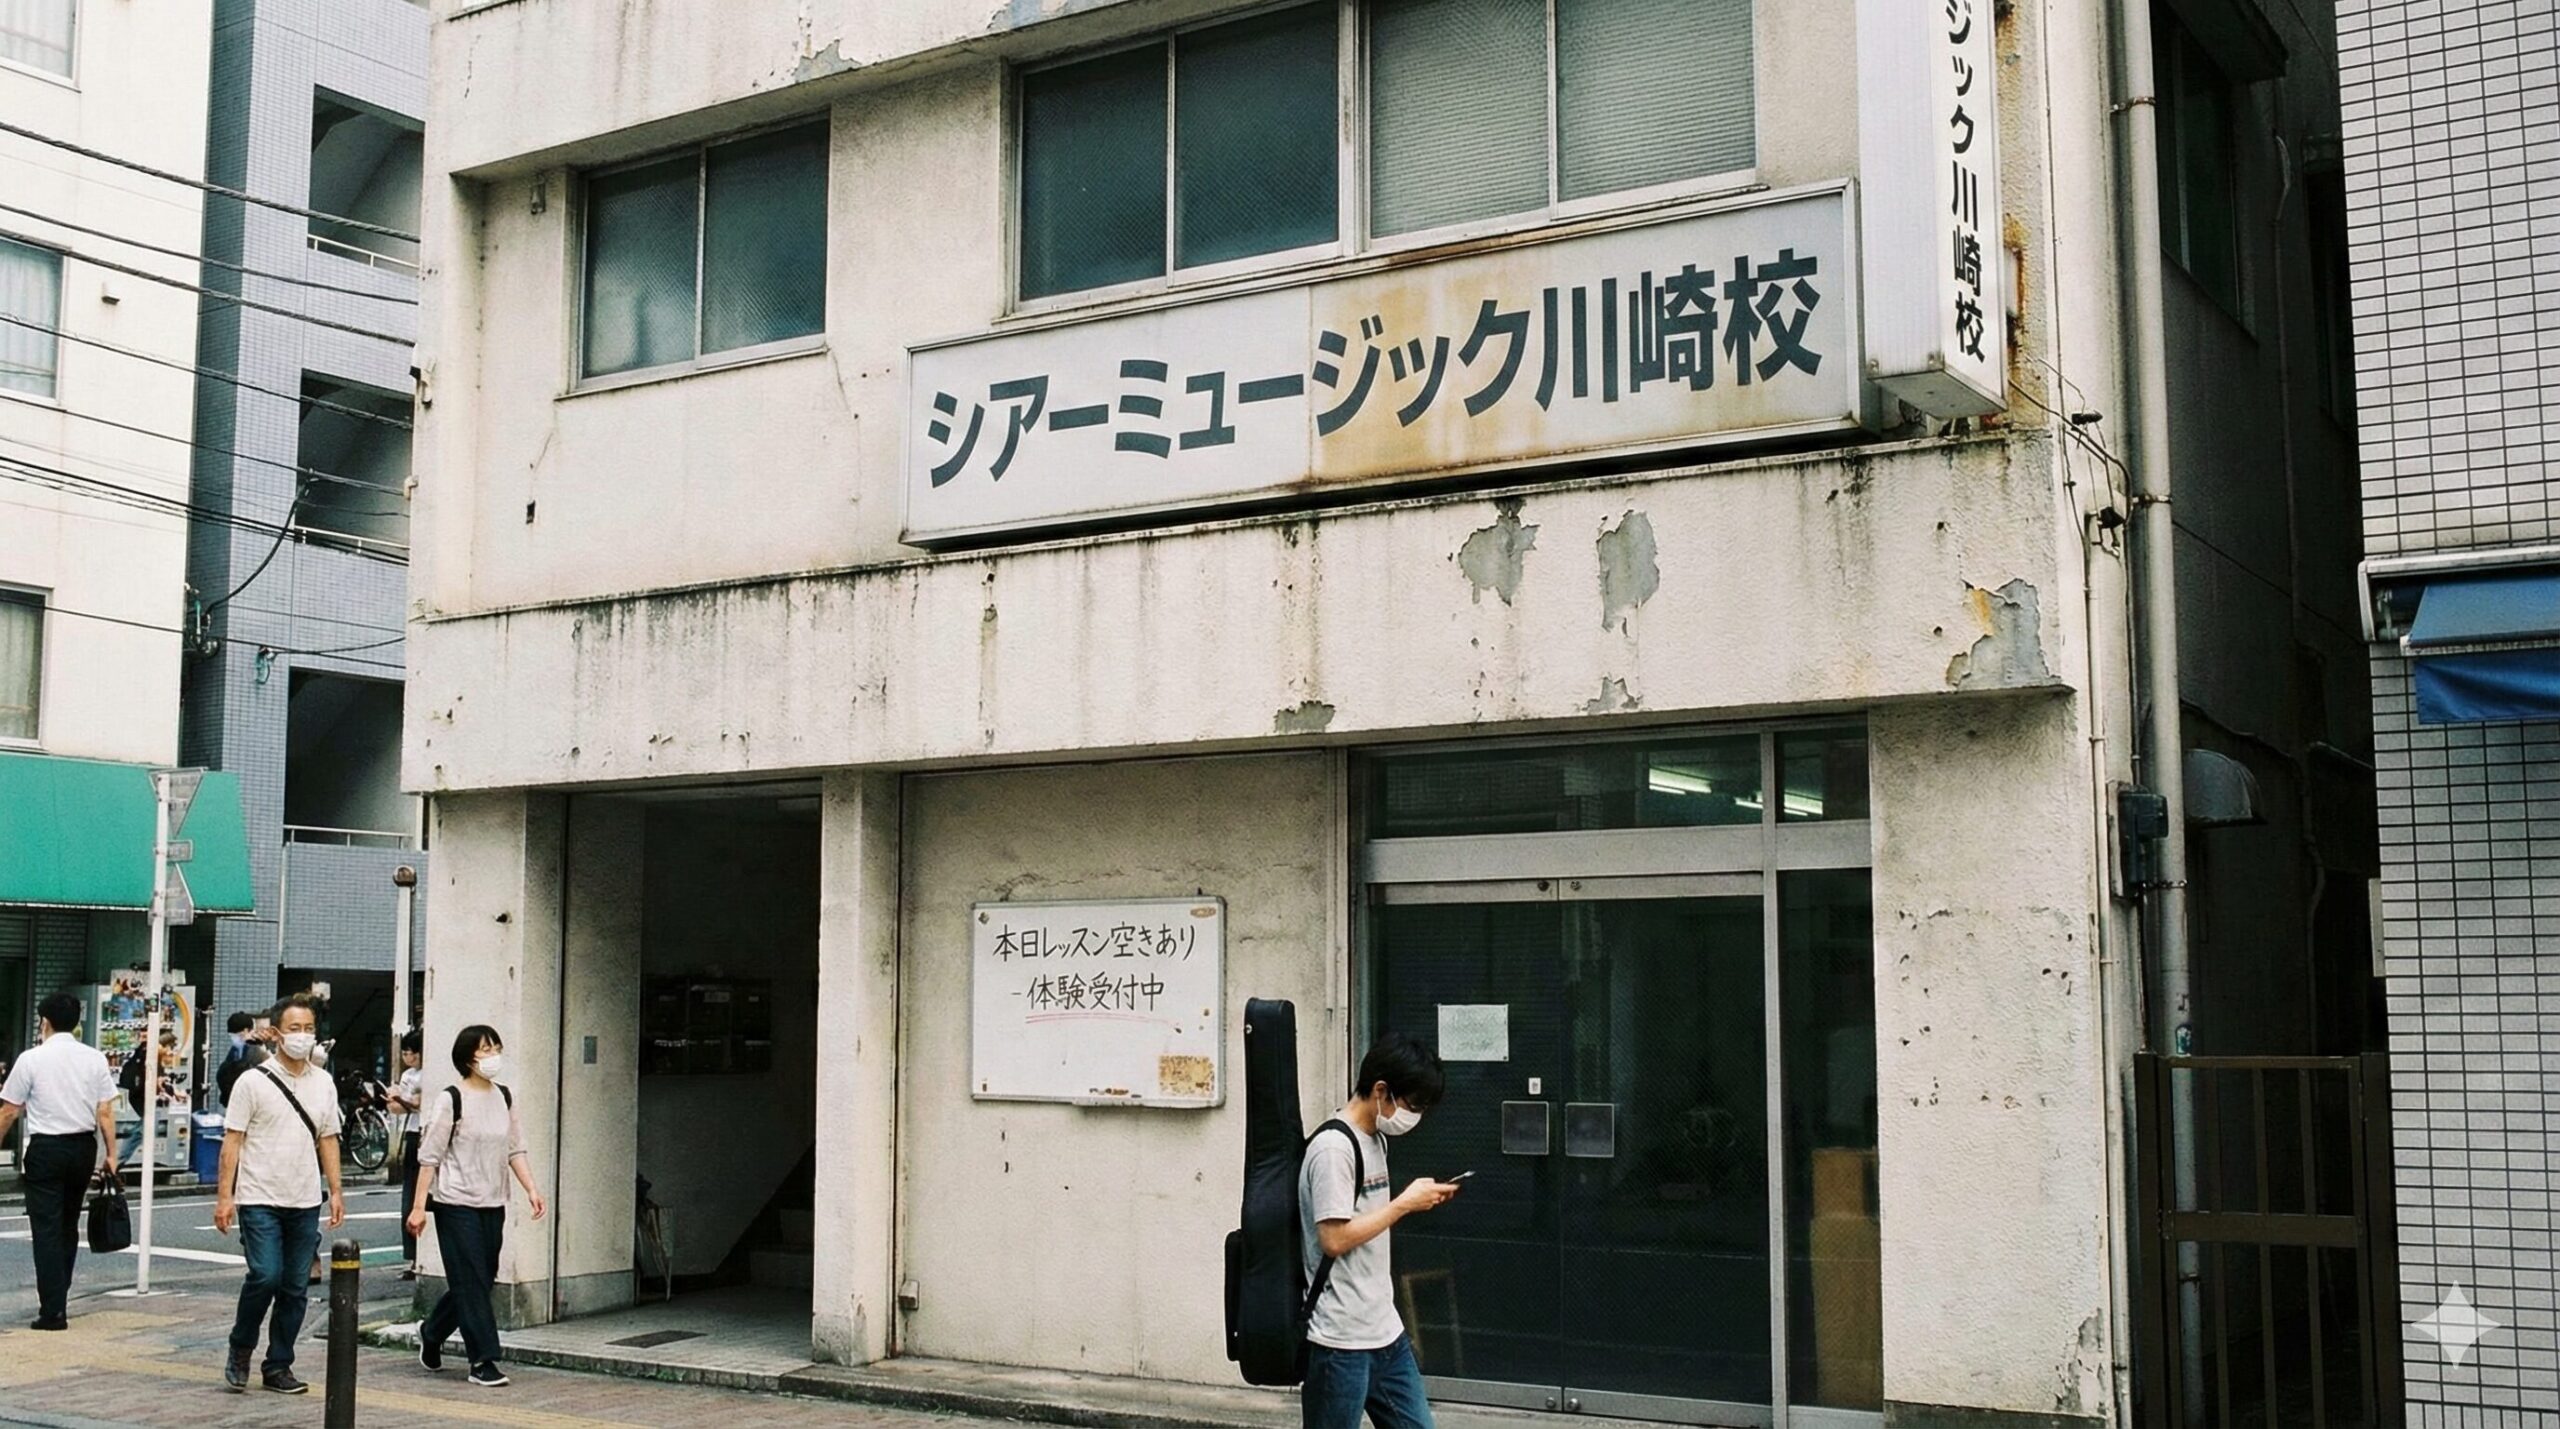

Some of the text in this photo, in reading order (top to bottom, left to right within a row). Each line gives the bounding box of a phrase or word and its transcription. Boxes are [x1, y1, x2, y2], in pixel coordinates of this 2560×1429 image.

[927, 247, 1823, 488] シアーミュージック川崎校
[993, 921, 1195, 962] 本日レッスン空きあり
